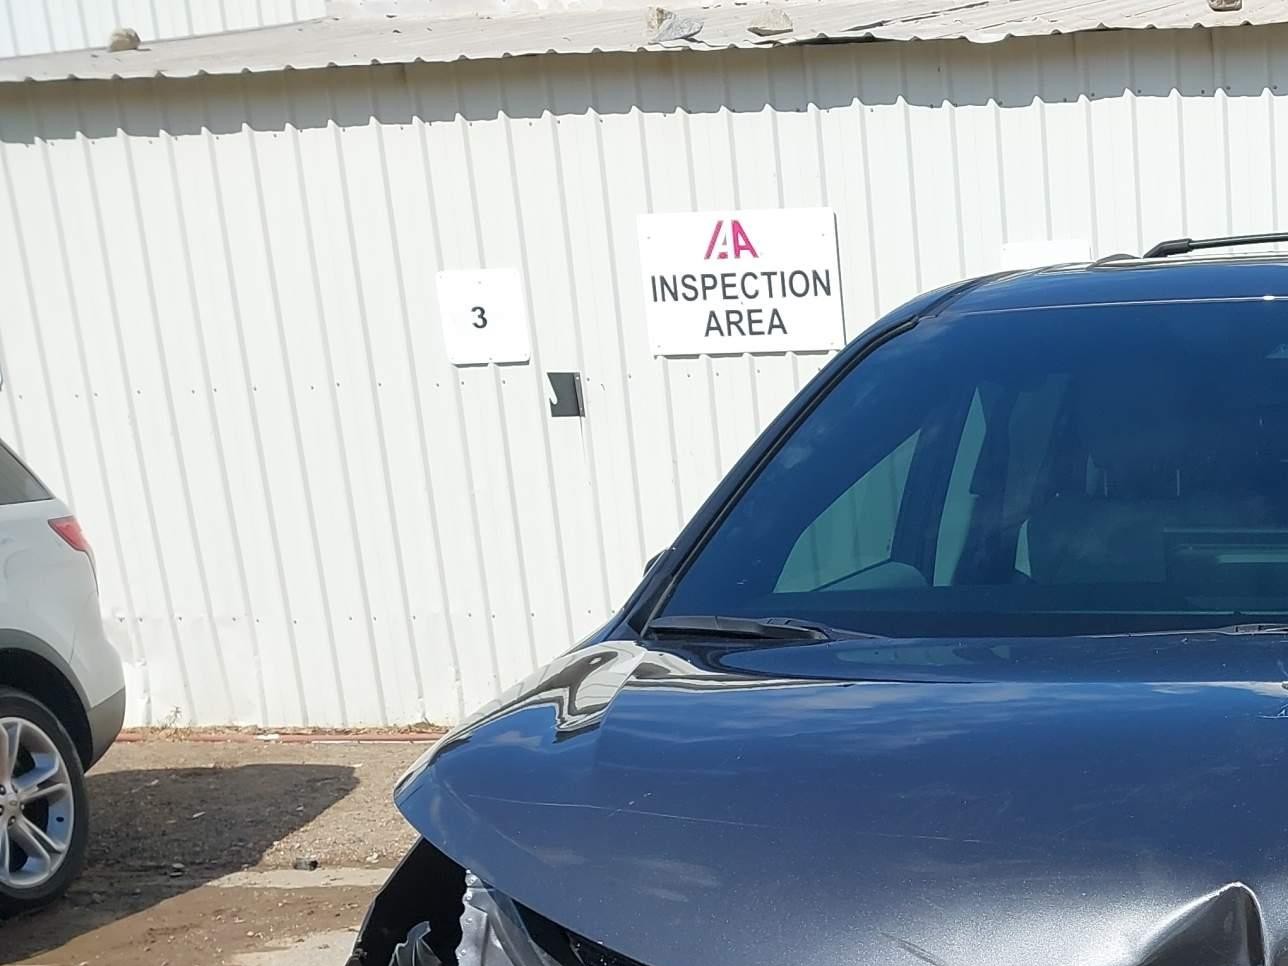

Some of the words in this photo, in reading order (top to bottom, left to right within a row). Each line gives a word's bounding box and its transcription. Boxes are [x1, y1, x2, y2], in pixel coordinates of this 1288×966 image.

[651, 269, 832, 303] INSPECTION
[471, 306, 488, 329] 3
[704, 308, 788, 337] AREA
